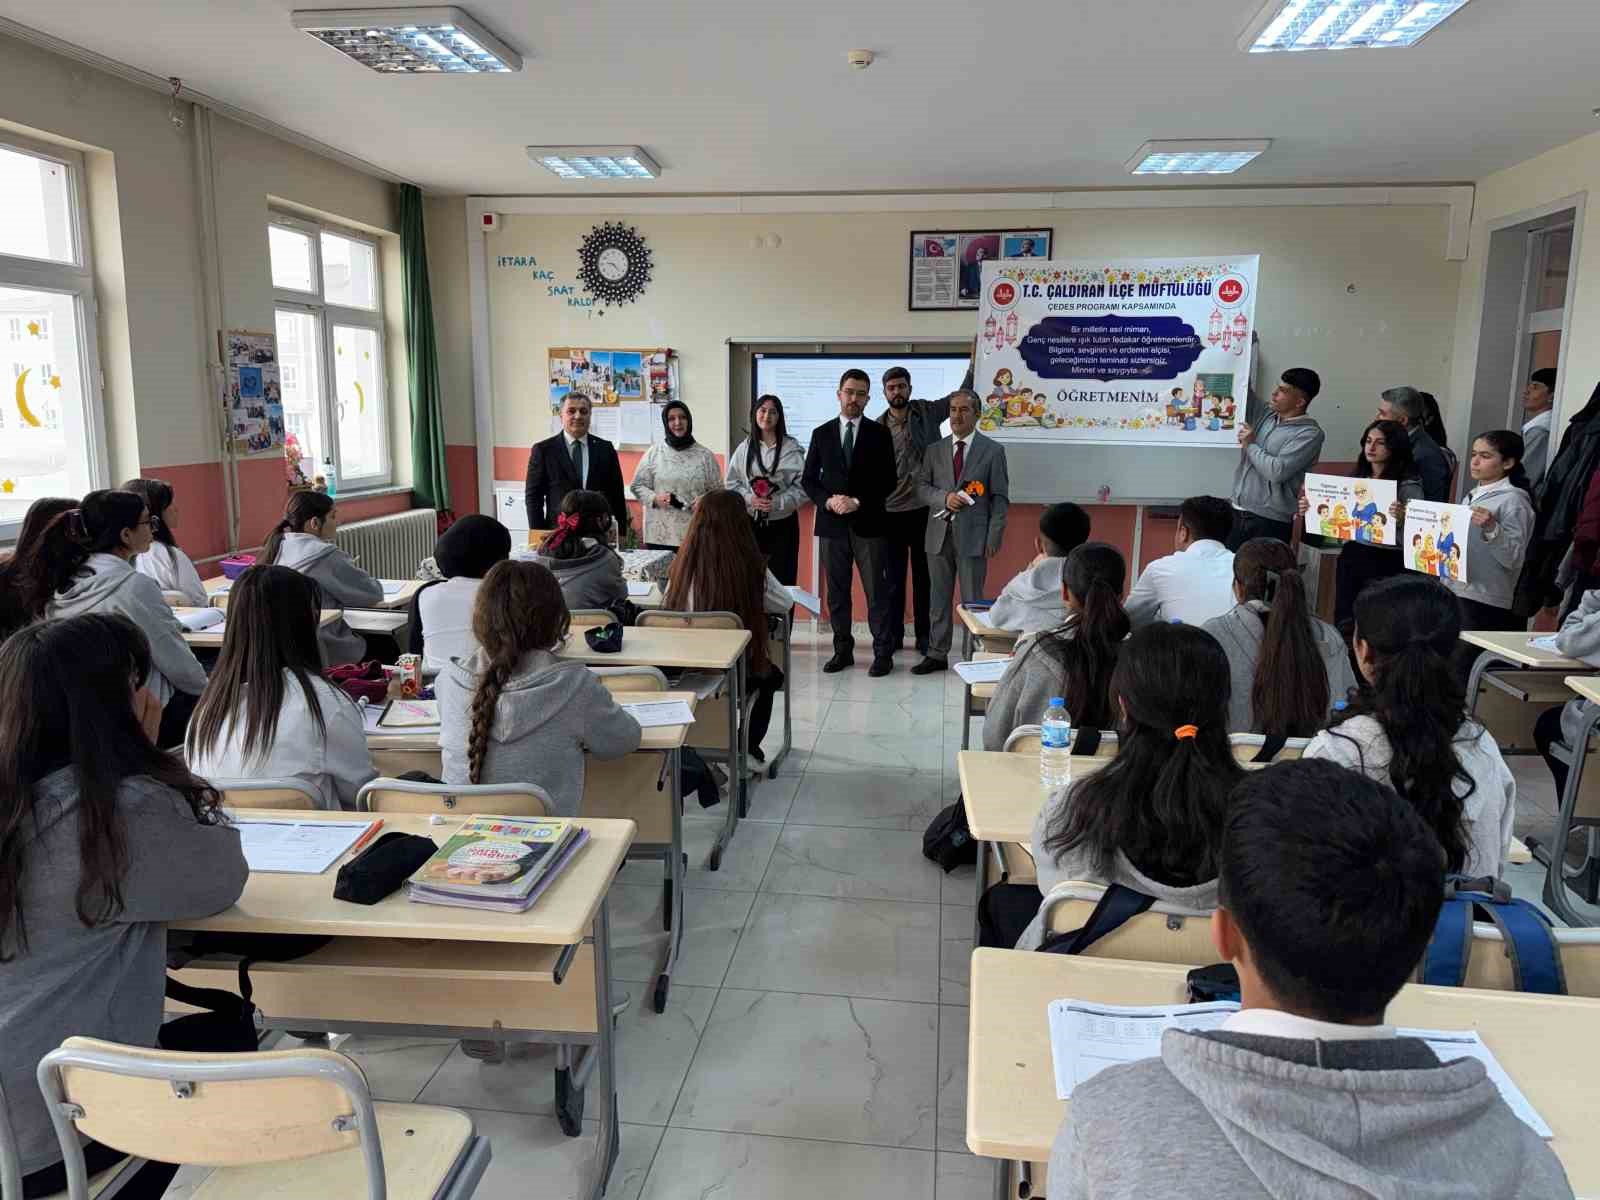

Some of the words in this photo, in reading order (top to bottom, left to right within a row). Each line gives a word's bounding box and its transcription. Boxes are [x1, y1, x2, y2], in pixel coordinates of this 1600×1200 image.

[533, 270, 554, 283] KAÇ
[547, 286, 576, 296] SAAT
[1022, 284, 1042, 298] T.C.
[1047, 284, 1104, 300] ÇALDIRAN
[1109, 281, 1134, 300] İLÇE
[1138, 279, 1212, 297] MÜFTÜLÜĞÜ
[1048, 303, 1075, 312] ÇEDES
[1077, 303, 1120, 311] PROGRAMI
[1121, 302, 1176, 311] KAPSAMINDA
[1027, 336, 1046, 344] Genç
[1048, 346, 1076, 355] Bilginin,
[1071, 366, 1096, 374] Minnet
[1056, 388, 1159, 402] ÖĞRETMENİM
